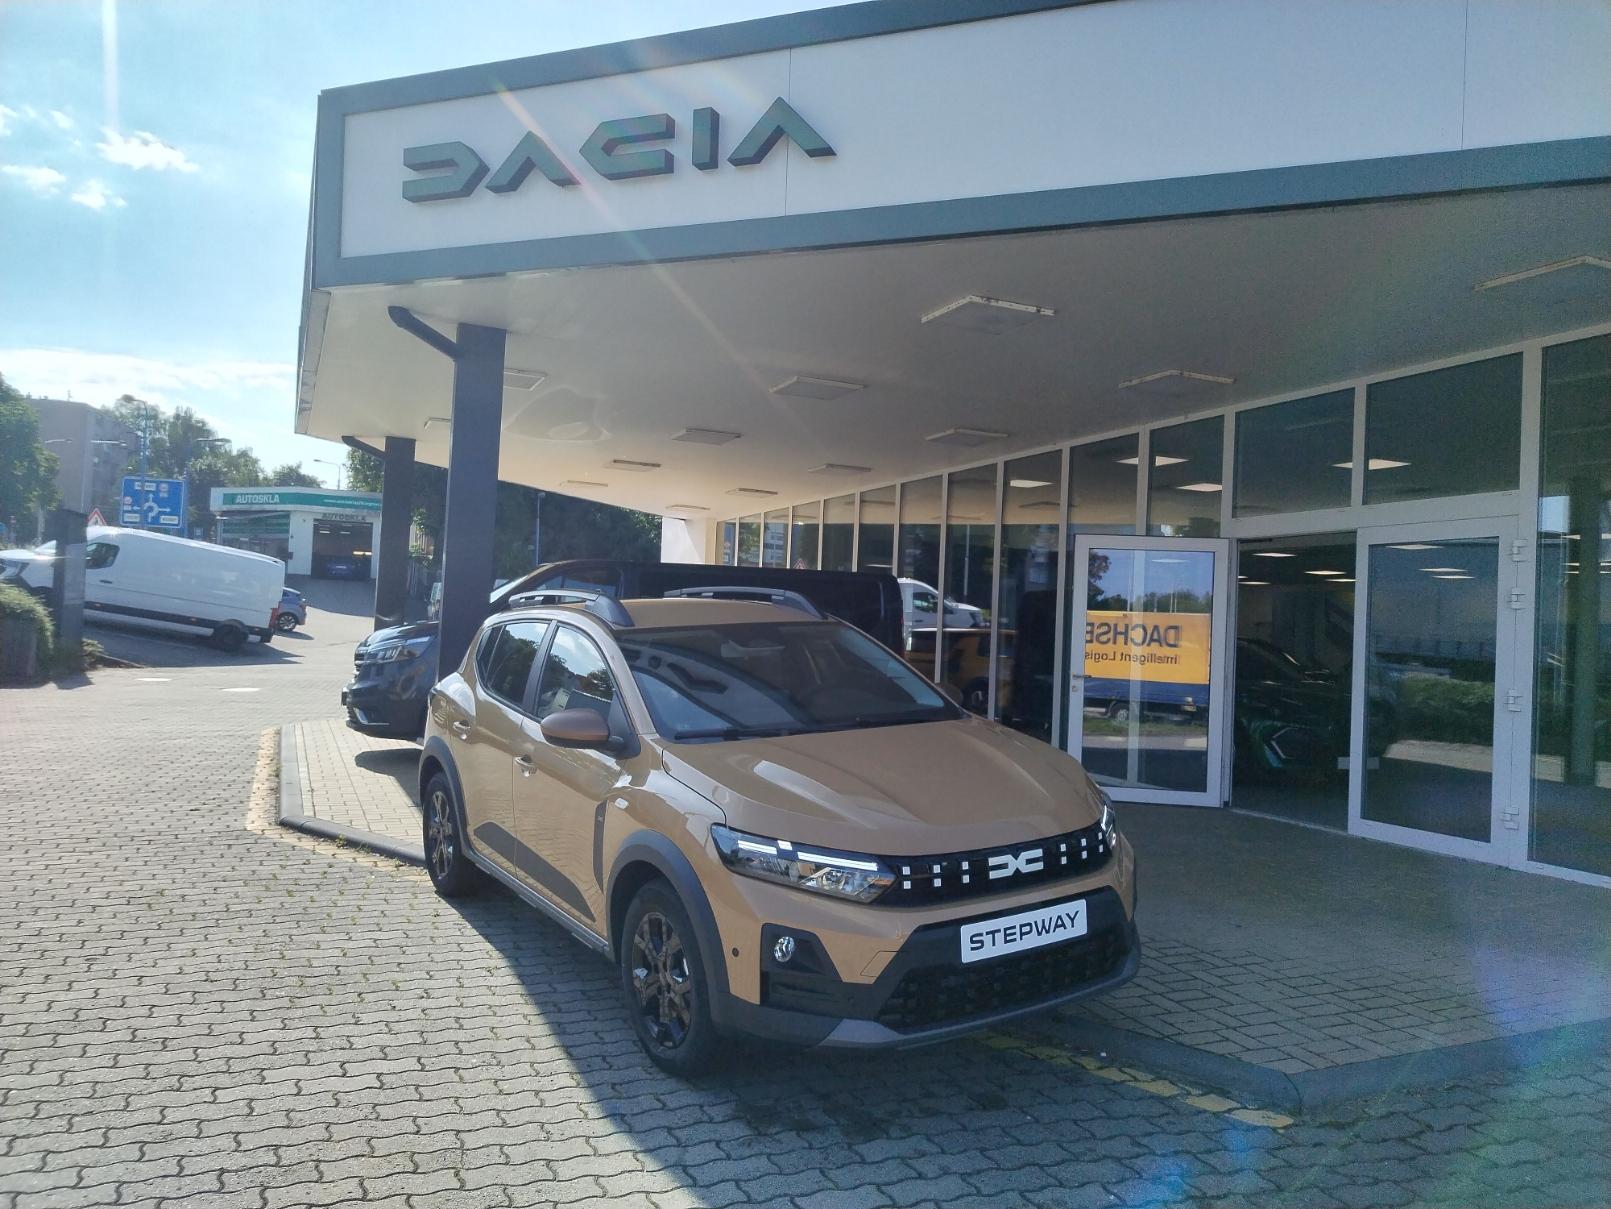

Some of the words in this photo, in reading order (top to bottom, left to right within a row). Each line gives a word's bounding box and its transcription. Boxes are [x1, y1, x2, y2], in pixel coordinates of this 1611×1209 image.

[402, 96, 837, 202] DACIA
[235, 493, 280, 505] AUTOSKLA
[969, 910, 1080, 951] STEPWAY
